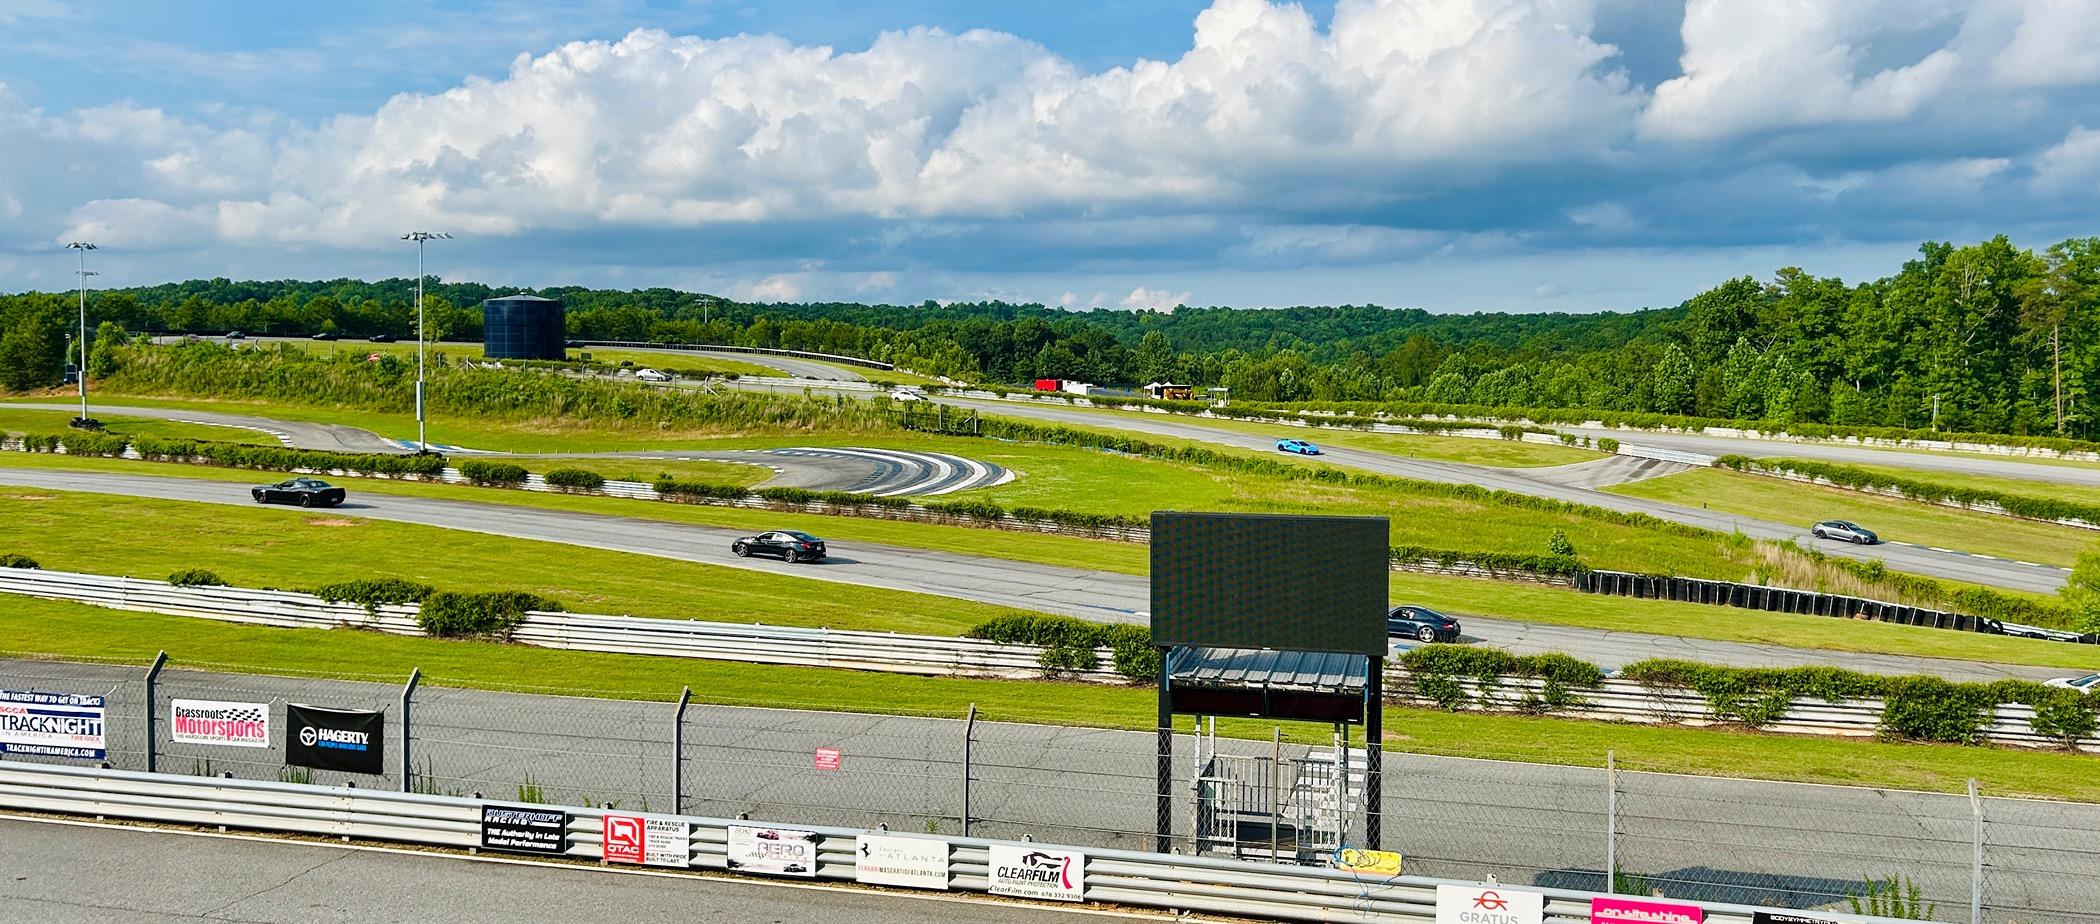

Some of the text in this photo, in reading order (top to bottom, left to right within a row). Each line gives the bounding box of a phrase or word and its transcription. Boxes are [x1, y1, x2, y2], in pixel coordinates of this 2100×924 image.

[11, 693, 34, 702] FASTEST
[34, 694, 48, 702] WAY
[49, 696, 56, 704] TO
[0, 706, 26, 714] SCCA
[176, 706, 224, 720] Grassroots
[0, 714, 101, 736] TRACKNIGHT
[176, 715, 264, 741] Motorsports
[484, 816, 528, 826] RACING
[501, 829, 534, 840] Authority
[536, 832, 543, 840] in
[544, 832, 560, 840] Late
[488, 837, 557, 849] Model Performance
[758, 842, 804, 856] AERO
[888, 853, 945, 863] ATLANTA
[998, 866, 1060, 882] CLEARFILM
[1460, 911, 1518, 924] GRATUS
